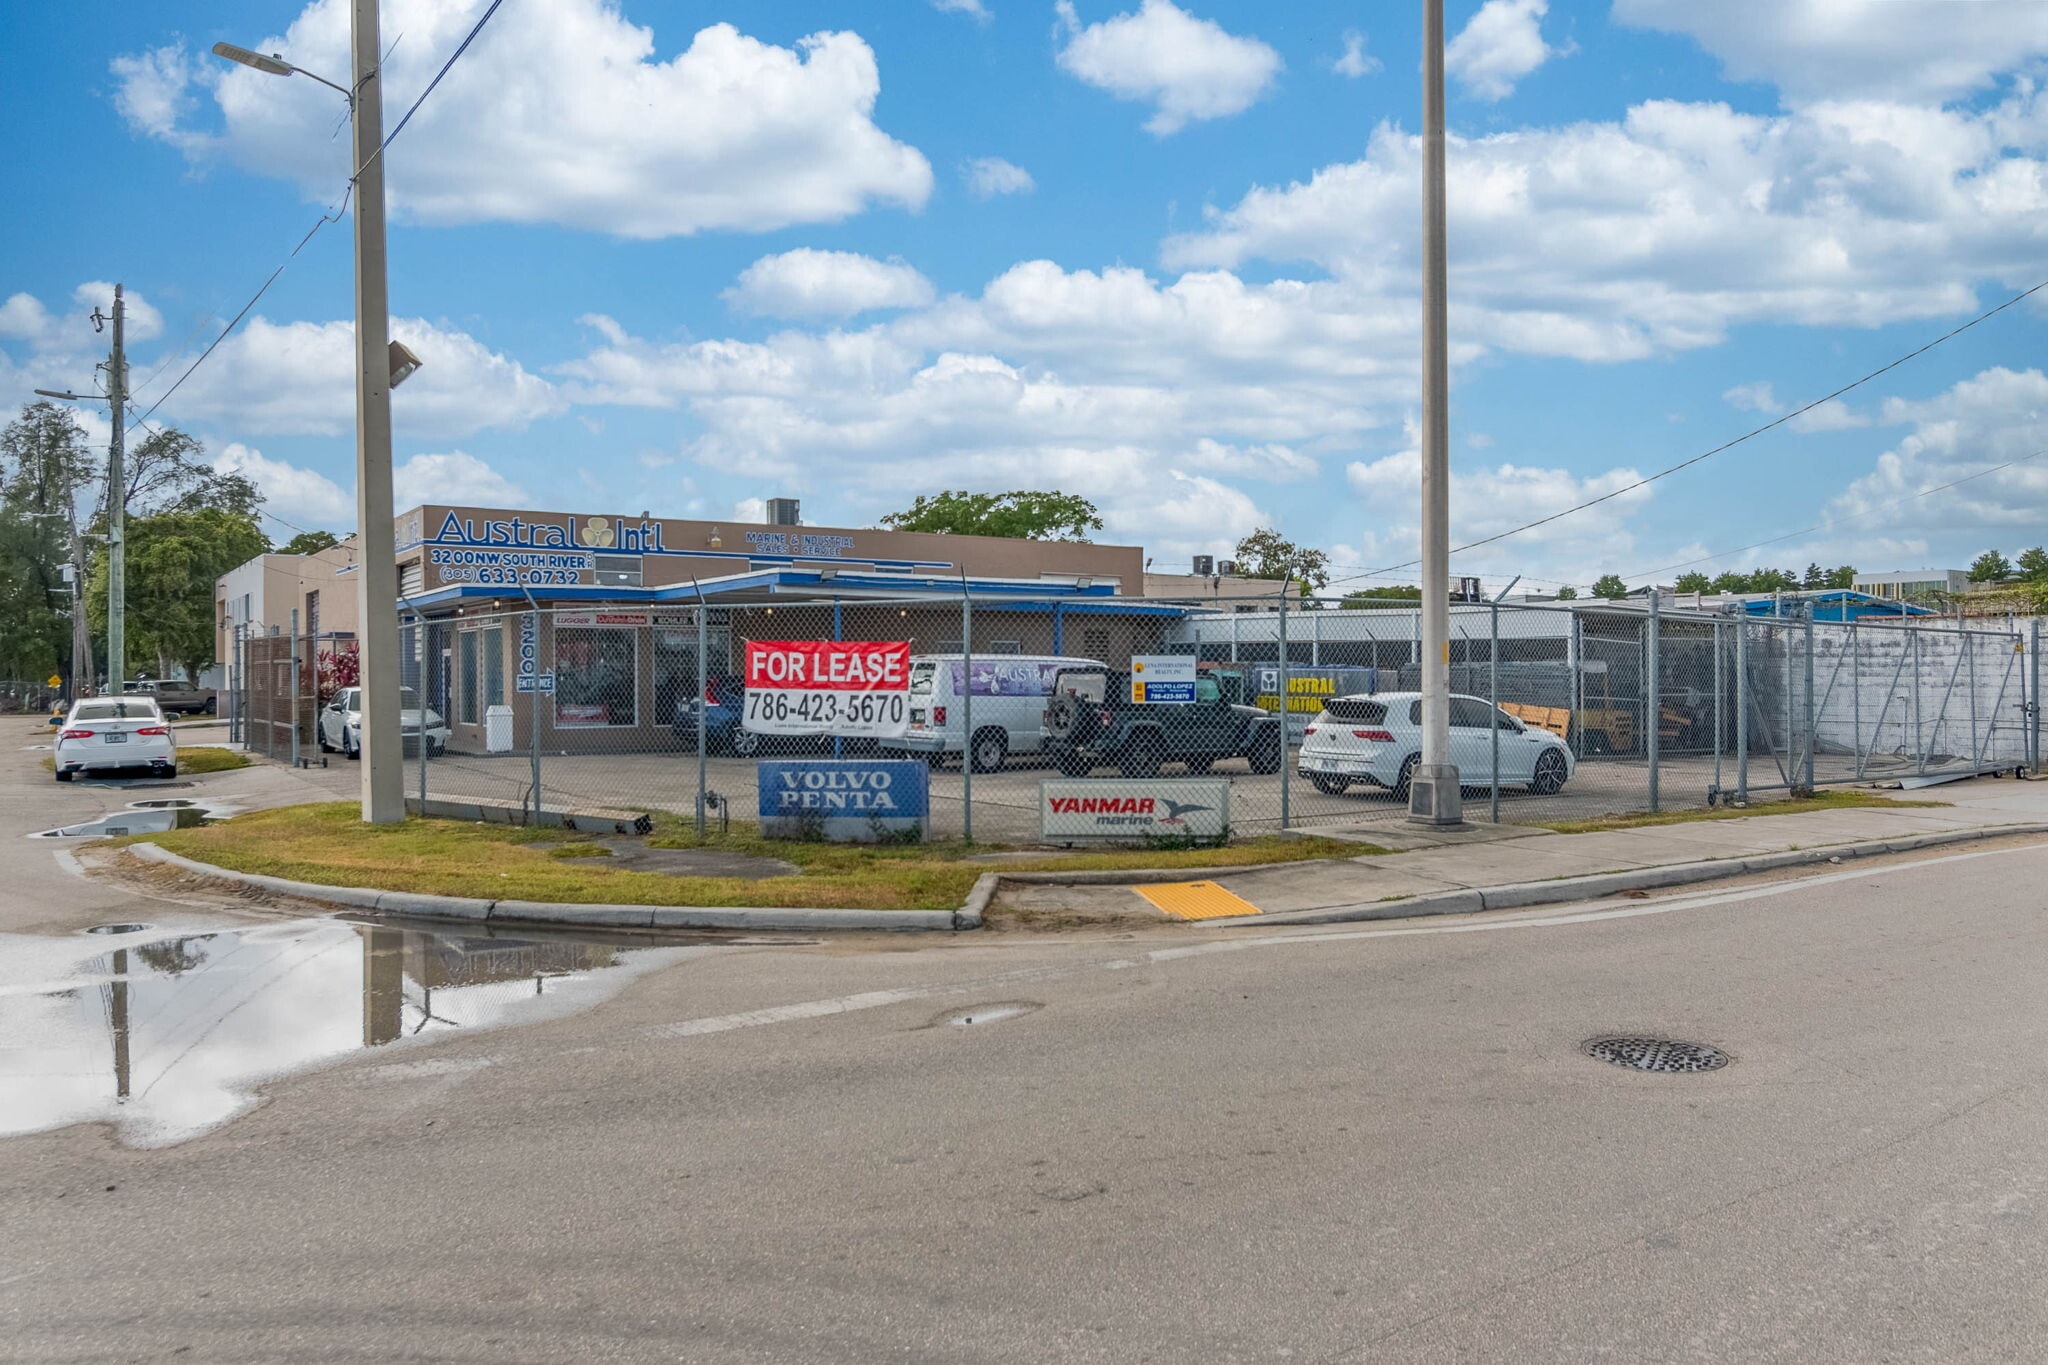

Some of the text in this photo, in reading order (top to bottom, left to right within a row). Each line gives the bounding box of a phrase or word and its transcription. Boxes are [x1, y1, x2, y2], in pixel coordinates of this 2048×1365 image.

[436, 510, 580, 548] Austral
[746, 532, 855, 547] MARINE & INDUSTRIAL
[756, 544, 842, 556] SALES SERVICE
[502, 553, 545, 567] SOUTH
[548, 554, 586, 568] RIVER
[440, 566, 477, 582] (305)
[752, 651, 901, 682] FOR LEASE
[519, 678, 552, 688] ENTRNCE
[1286, 677, 1335, 693] USTRAL
[749, 692, 903, 723] 786-423-5670
[780, 771, 892, 789] VOLVO
[779, 791, 898, 809] PENTA
[1049, 798, 1155, 814] YANMAR
[1096, 815, 1154, 825] marine
